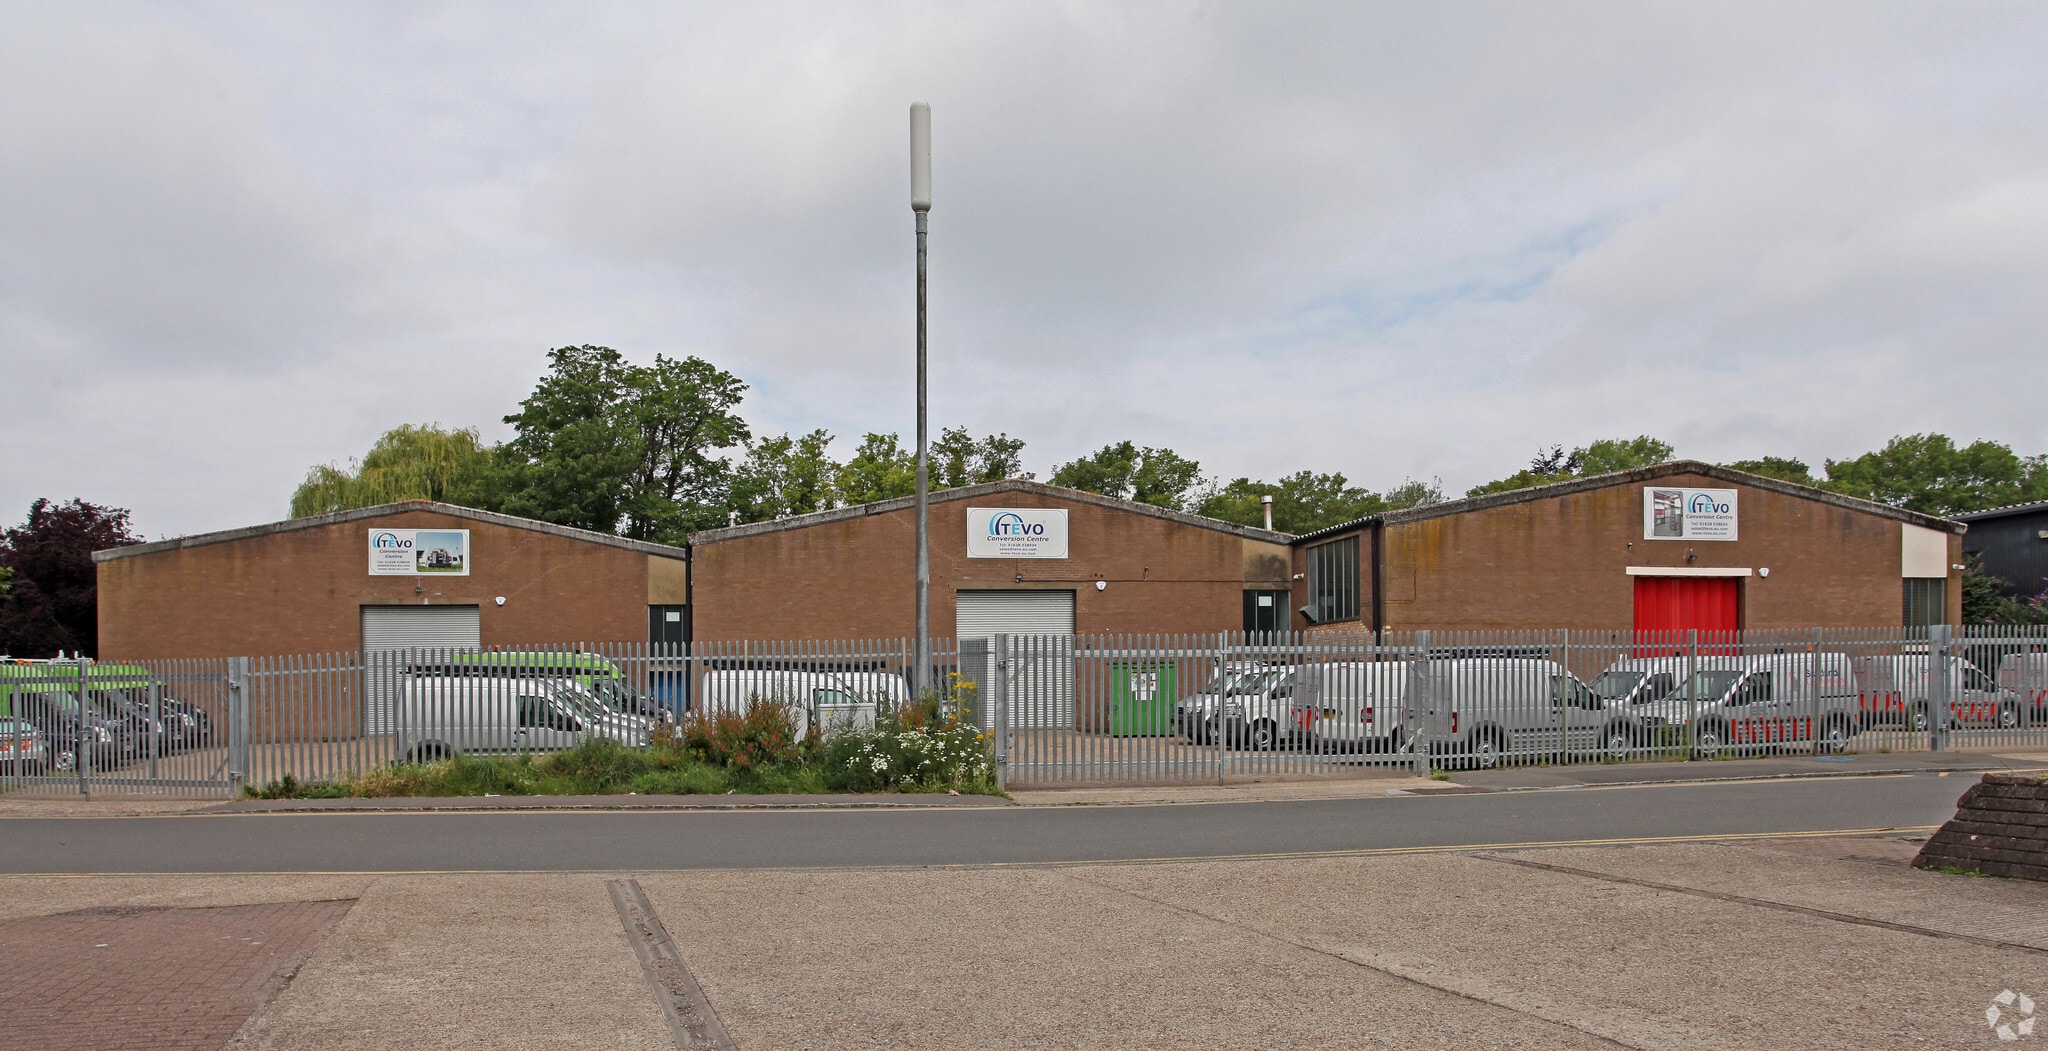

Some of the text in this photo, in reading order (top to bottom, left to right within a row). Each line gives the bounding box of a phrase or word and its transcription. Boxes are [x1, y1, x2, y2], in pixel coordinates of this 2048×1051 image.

[1696, 502, 1729, 513] TEVO
[1001, 523, 1044, 535] TEVO
[381, 539, 412, 548] TEVO
